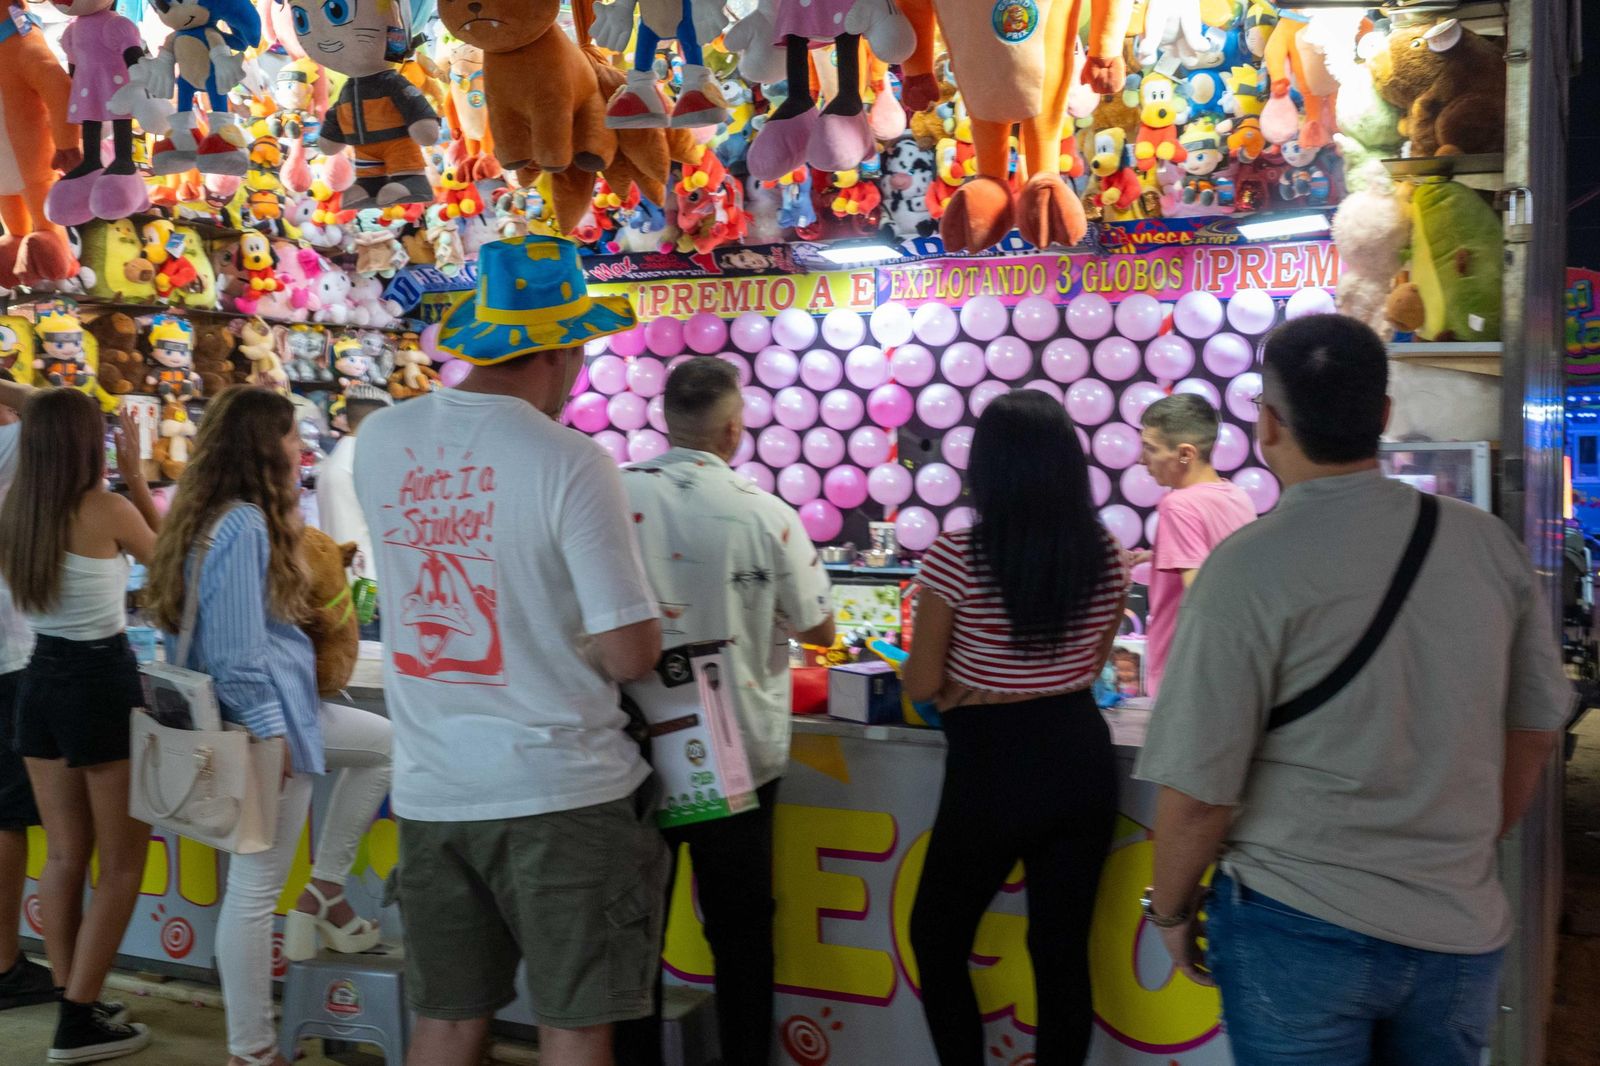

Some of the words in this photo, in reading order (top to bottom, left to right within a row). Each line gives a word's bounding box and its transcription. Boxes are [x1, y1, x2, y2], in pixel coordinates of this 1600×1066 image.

[589, 255, 639, 282] Max
[637, 276, 797, 318] ¡PREMIO
[808, 274, 835, 309] A
[889, 262, 1047, 301] EXPLOTANDO
[1054, 255, 1075, 295] 3
[1081, 256, 1184, 294] GLOBOS
[455, 465, 477, 501] I
[402, 500, 495, 548] Stinker!
